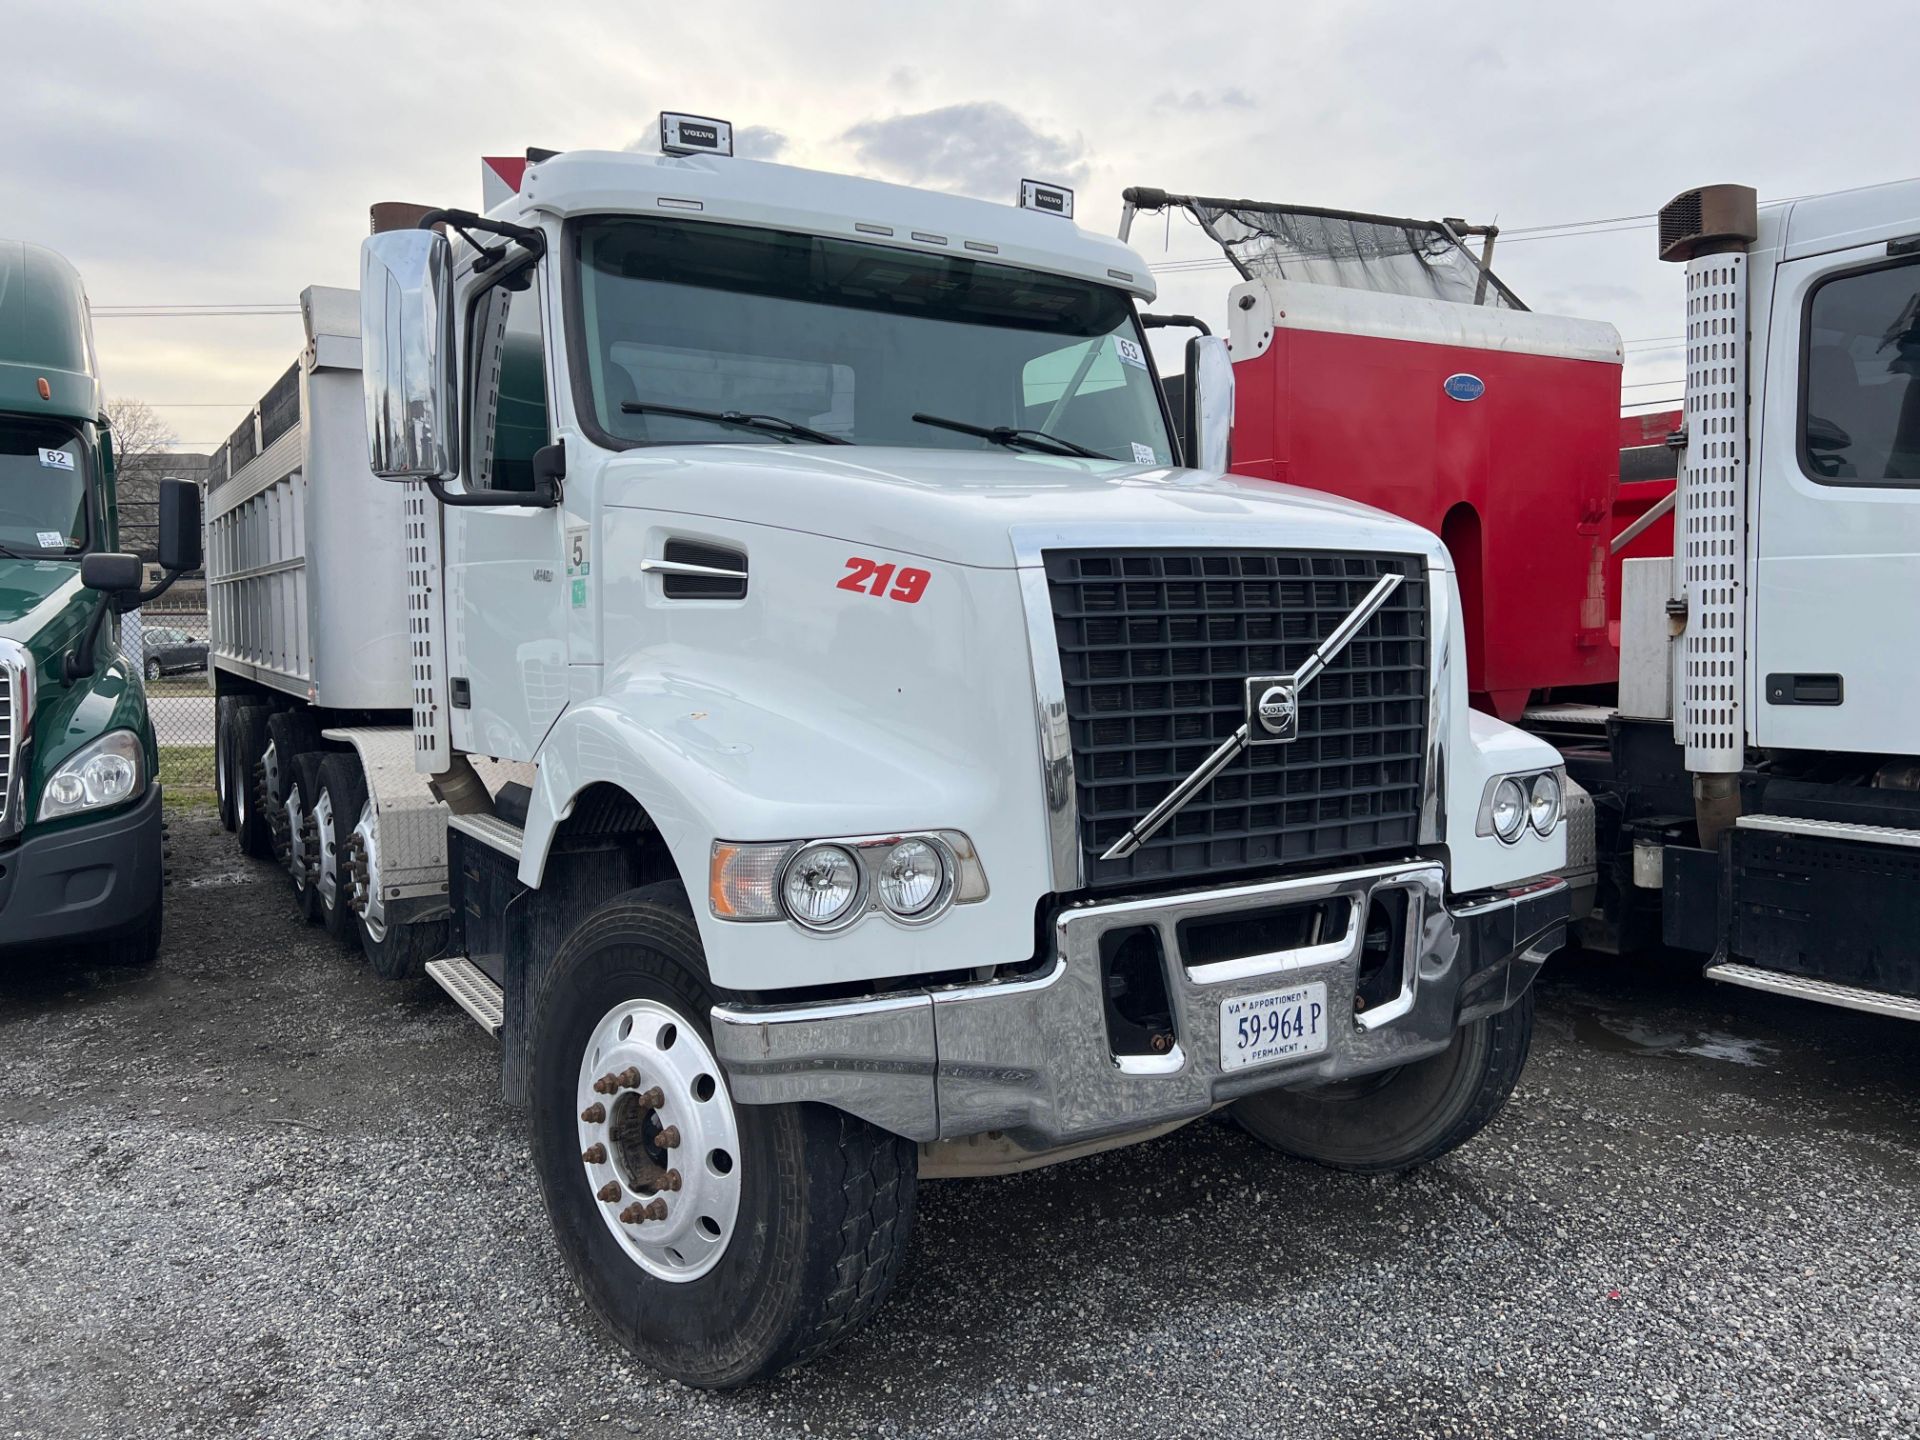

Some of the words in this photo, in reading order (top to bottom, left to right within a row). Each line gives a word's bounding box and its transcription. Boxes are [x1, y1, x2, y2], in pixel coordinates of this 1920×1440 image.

[682, 128, 715, 139] VOLVO
[1037, 194, 1061, 205] VOLVO
[1120, 340, 1138, 360] 63
[47, 450, 65, 464] 62
[572, 535, 583, 567] 5
[835, 556, 932, 604] 219
[1261, 705, 1294, 714] VOLVO
[1228, 1004, 1241, 1014] VA
[1248, 993, 1302, 1010] APPORTIONED
[1237, 1005, 1304, 1049] 59-964
[1310, 1002, 1322, 1035] P
[1252, 1043, 1298, 1060] PERMANENT
